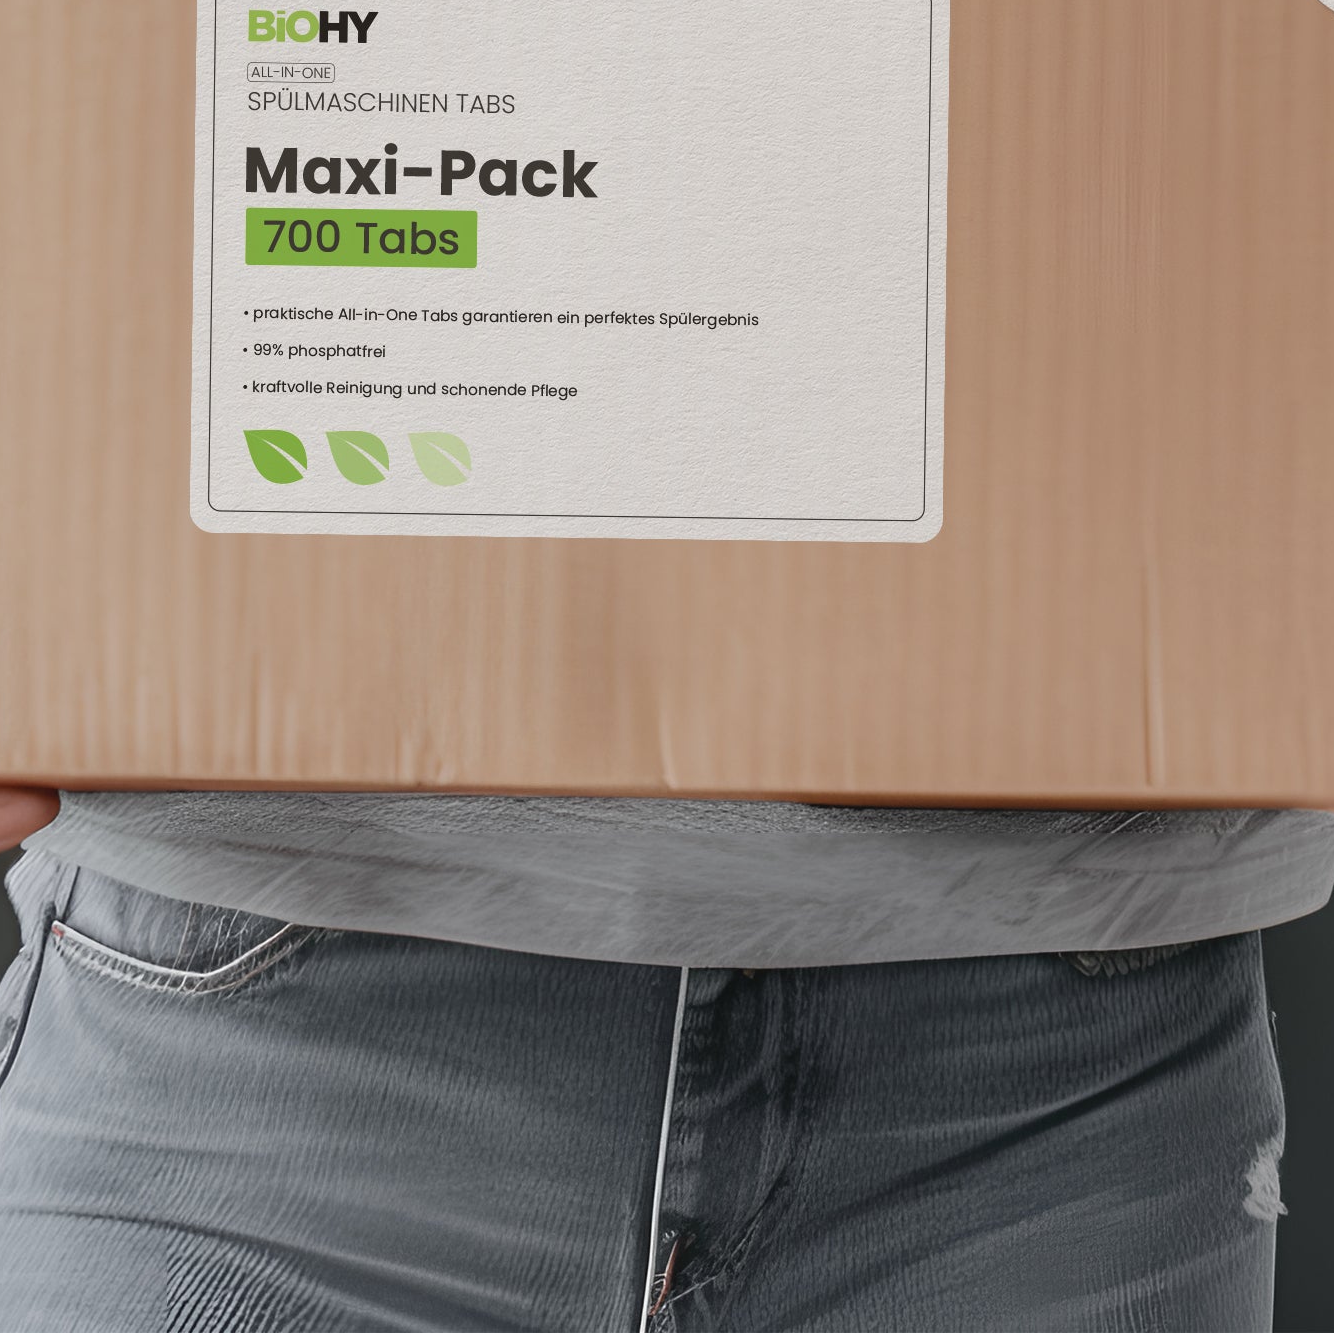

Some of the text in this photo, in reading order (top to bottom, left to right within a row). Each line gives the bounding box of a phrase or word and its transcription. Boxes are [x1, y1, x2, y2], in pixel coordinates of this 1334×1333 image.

[251, 64, 332, 81] ALL-IN-ONE
[248, 87, 515, 114] SPÜLMASCHINEN TABS
[245, 142, 599, 198] Maxi-Pack
[263, 219, 459, 256] 700 Tabs
[253, 306, 759, 330] praktische All-in-One Tabs garantieren ein perfektes Spülergebnis
[253, 343, 386, 361] 99% phosphatfrei
[252, 379, 578, 401] kraftvolle Reinigung und schonende Pflege
